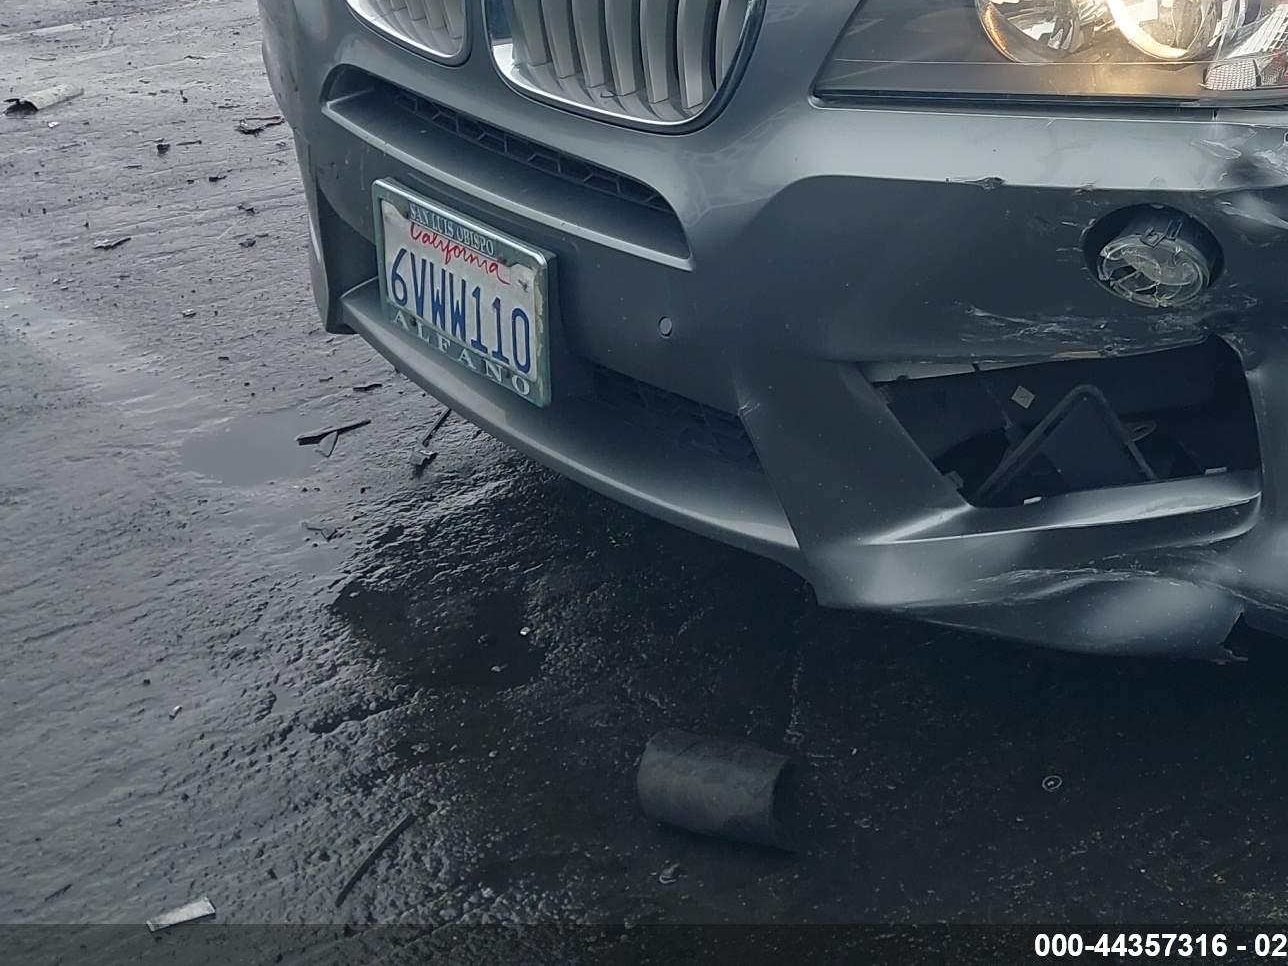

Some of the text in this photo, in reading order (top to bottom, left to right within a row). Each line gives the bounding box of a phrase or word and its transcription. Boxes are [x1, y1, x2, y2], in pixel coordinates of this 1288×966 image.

[409, 203, 494, 256] SAN LUIS OBISPO
[411, 222, 510, 285] California
[391, 248, 532, 374] 6VWW110
[394, 310, 531, 396] ALFANO
